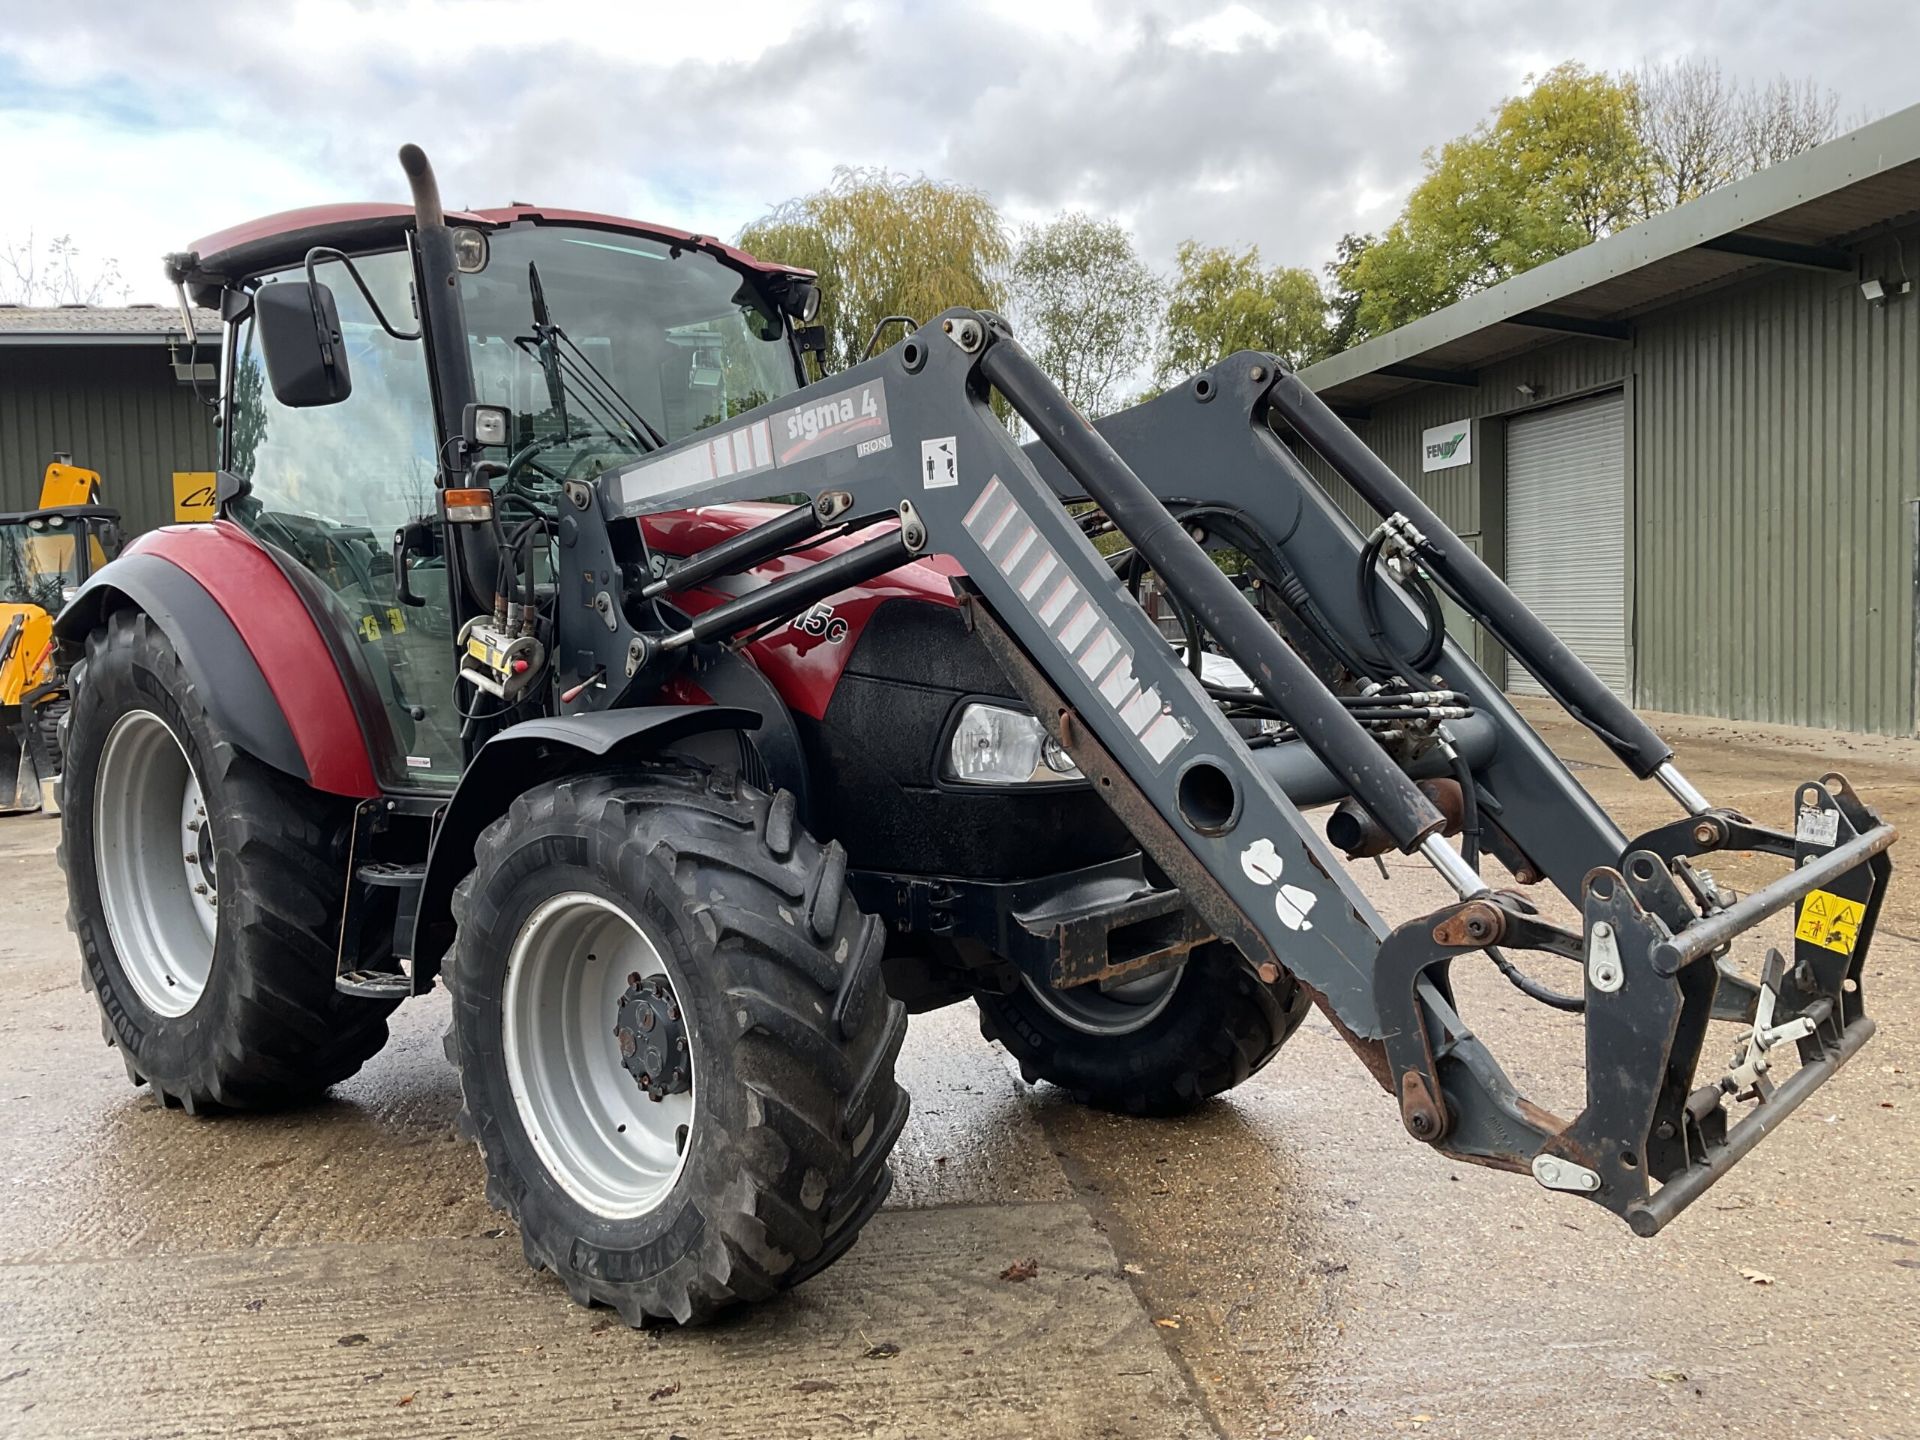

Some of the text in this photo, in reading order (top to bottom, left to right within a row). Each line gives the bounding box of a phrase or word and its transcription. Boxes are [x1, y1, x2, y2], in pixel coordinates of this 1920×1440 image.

[787, 389, 878, 441] sigma 4
[859, 436, 887, 455] IRON
[180, 486, 216, 507] Ch
